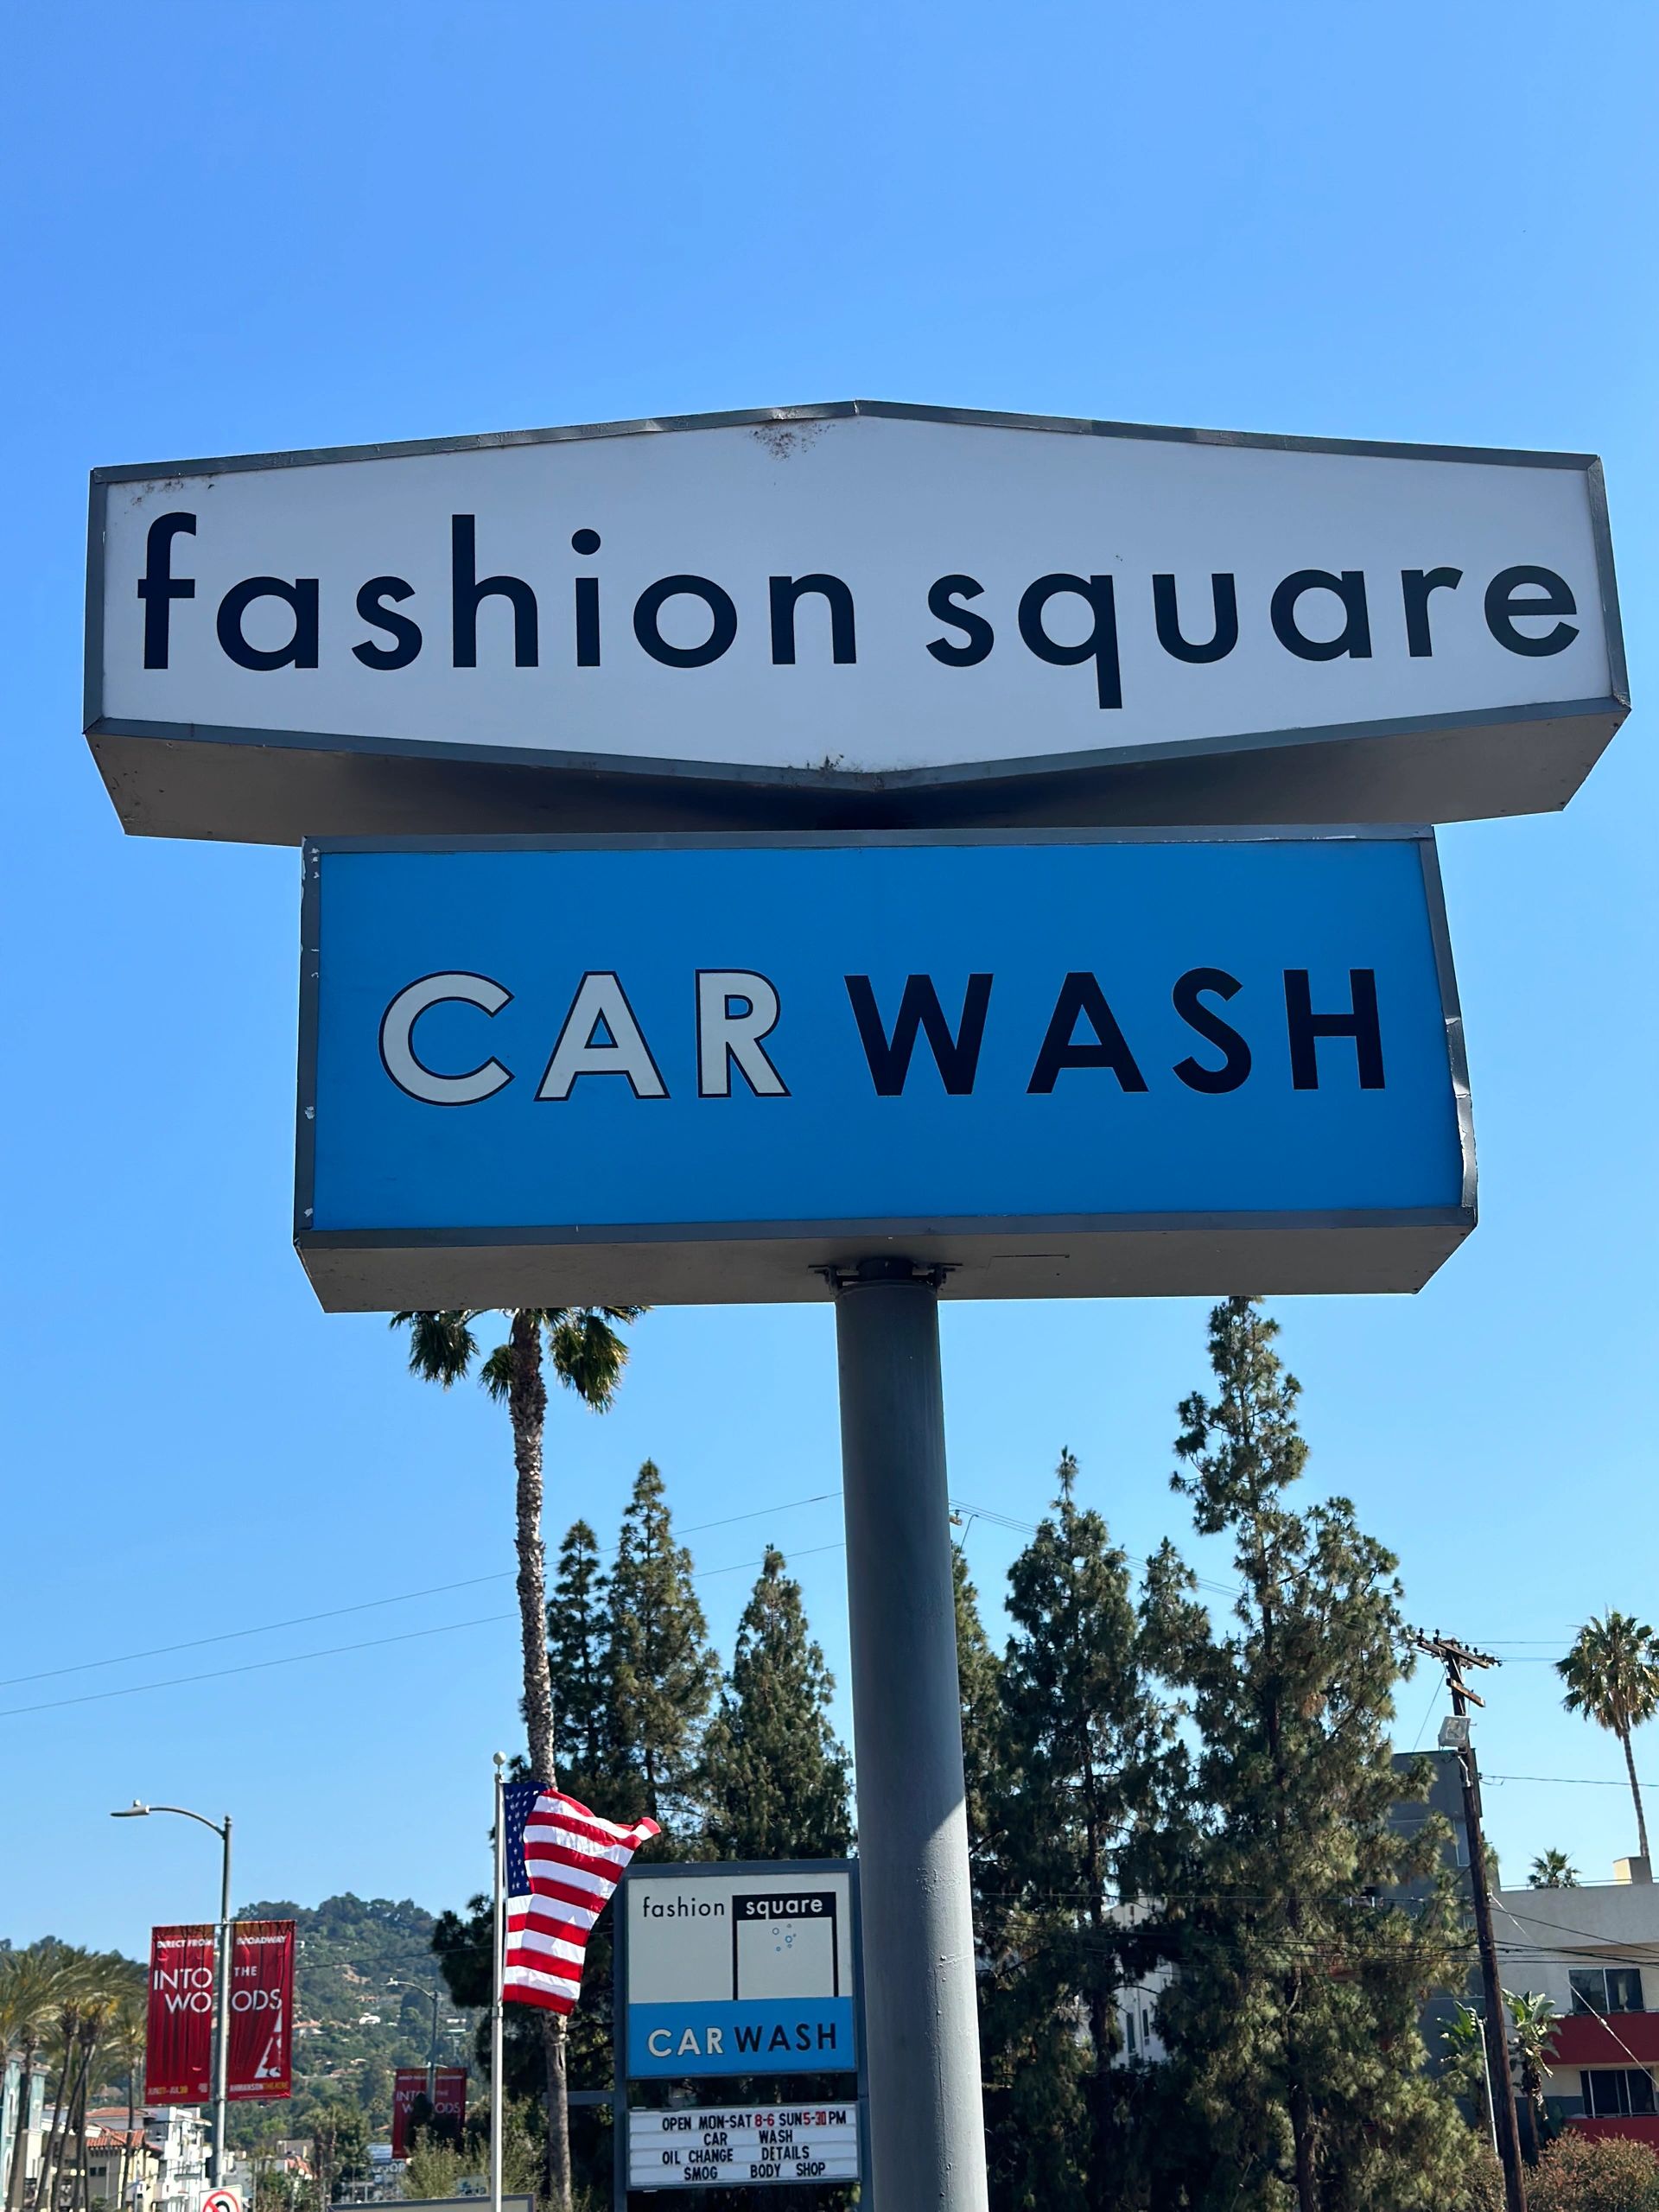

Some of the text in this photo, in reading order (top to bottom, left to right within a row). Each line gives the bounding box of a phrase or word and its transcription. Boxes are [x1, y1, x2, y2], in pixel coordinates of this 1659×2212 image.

[137, 512, 1580, 709] fashion square
[378, 967, 1387, 1107] CAR WASH
[643, 1896, 823, 1920] fashion square
[154, 1967, 213, 1991] INTO
[233, 1966, 257, 1977] THE
[648, 2022, 836, 2057] CAR WASH
[662, 2116, 691, 2131] OPEN
[699, 2114, 752, 2130] MON-SAT
[754, 2113, 774, 2126] 8-6
[779, 2112, 802, 2126] SUN
[829, 2110, 847, 2125] PM
[703, 2130, 793, 2146] CAR WASH
[662, 2145, 810, 2164] OIL CHANGE DETAILS
[683, 2161, 826, 2181] SMOG BODY SHOP
